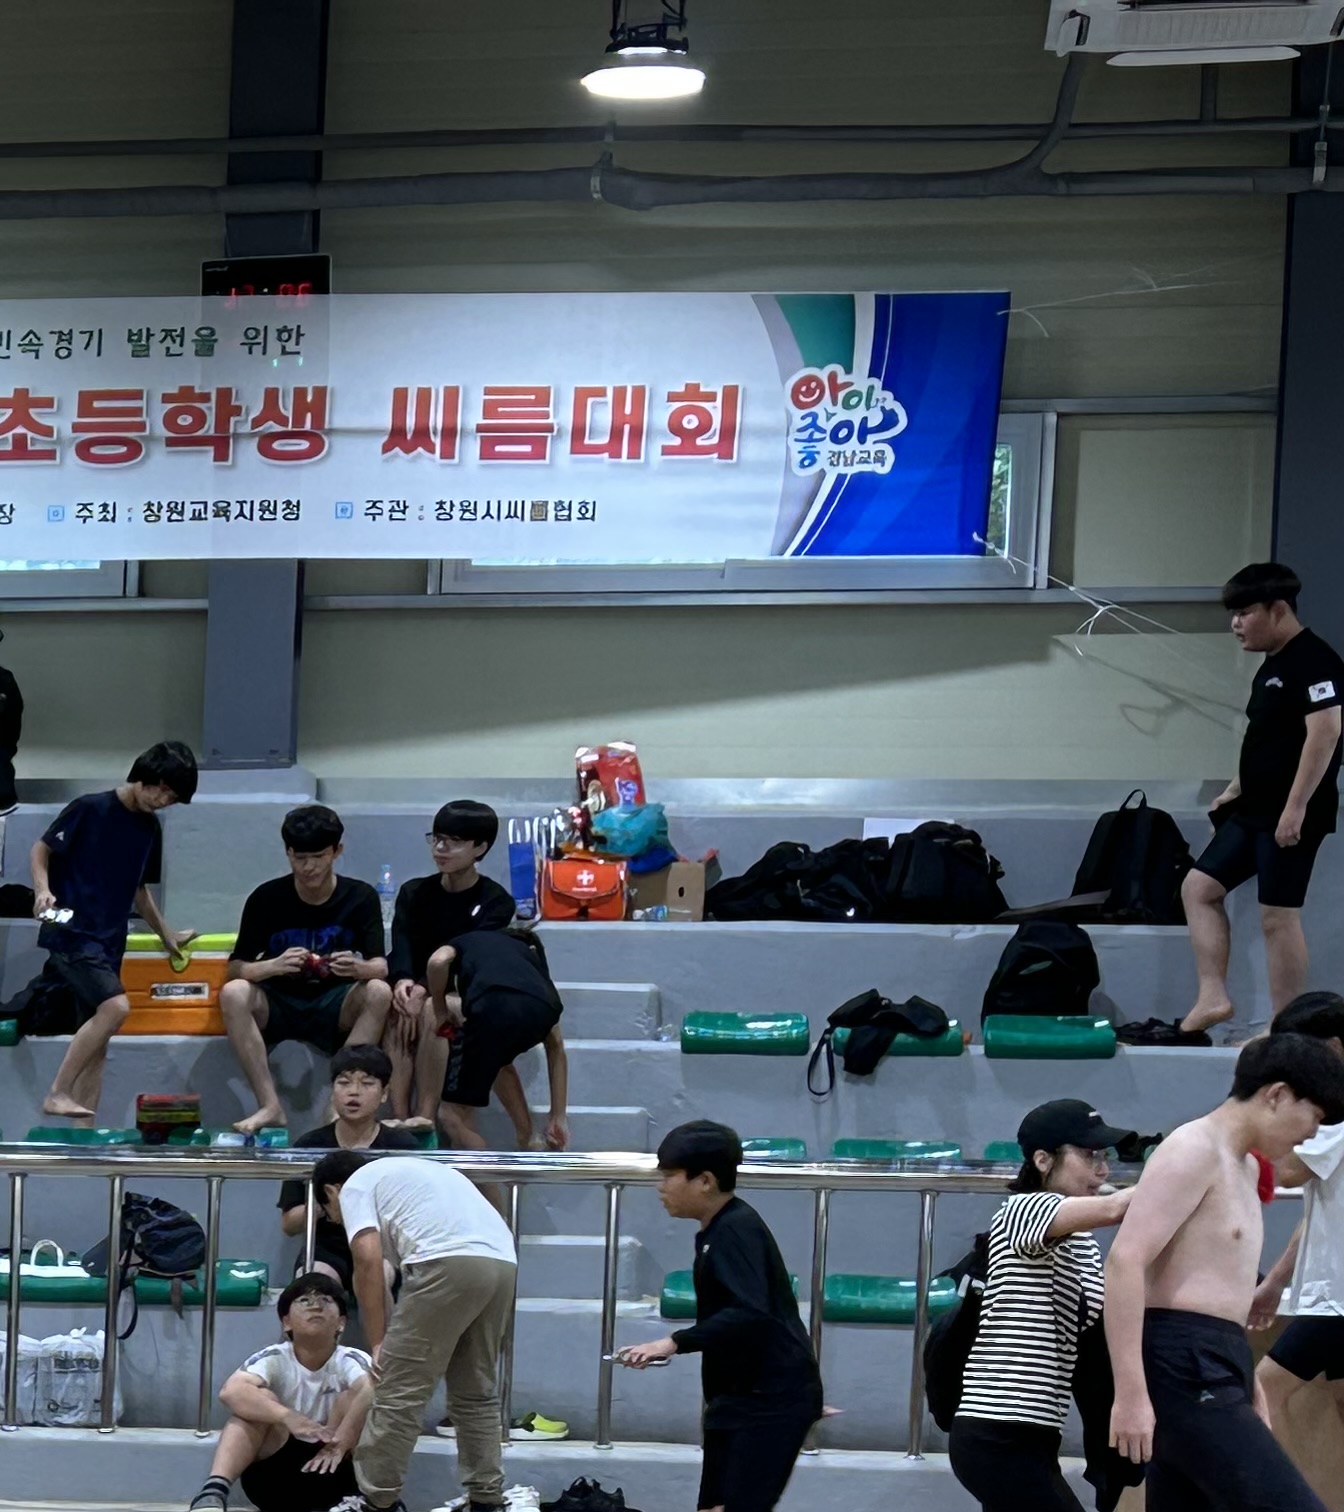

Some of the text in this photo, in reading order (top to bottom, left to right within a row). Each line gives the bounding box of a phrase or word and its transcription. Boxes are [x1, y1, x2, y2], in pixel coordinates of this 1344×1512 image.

[127, 326, 218, 358] 발전을
[240, 325, 305, 356] 위한
[381, 382, 740, 461] 씨름대회
[75, 502, 117, 524] 주최
[143, 499, 302, 523] 창원교육지원청
[364, 500, 410, 522] 주관
